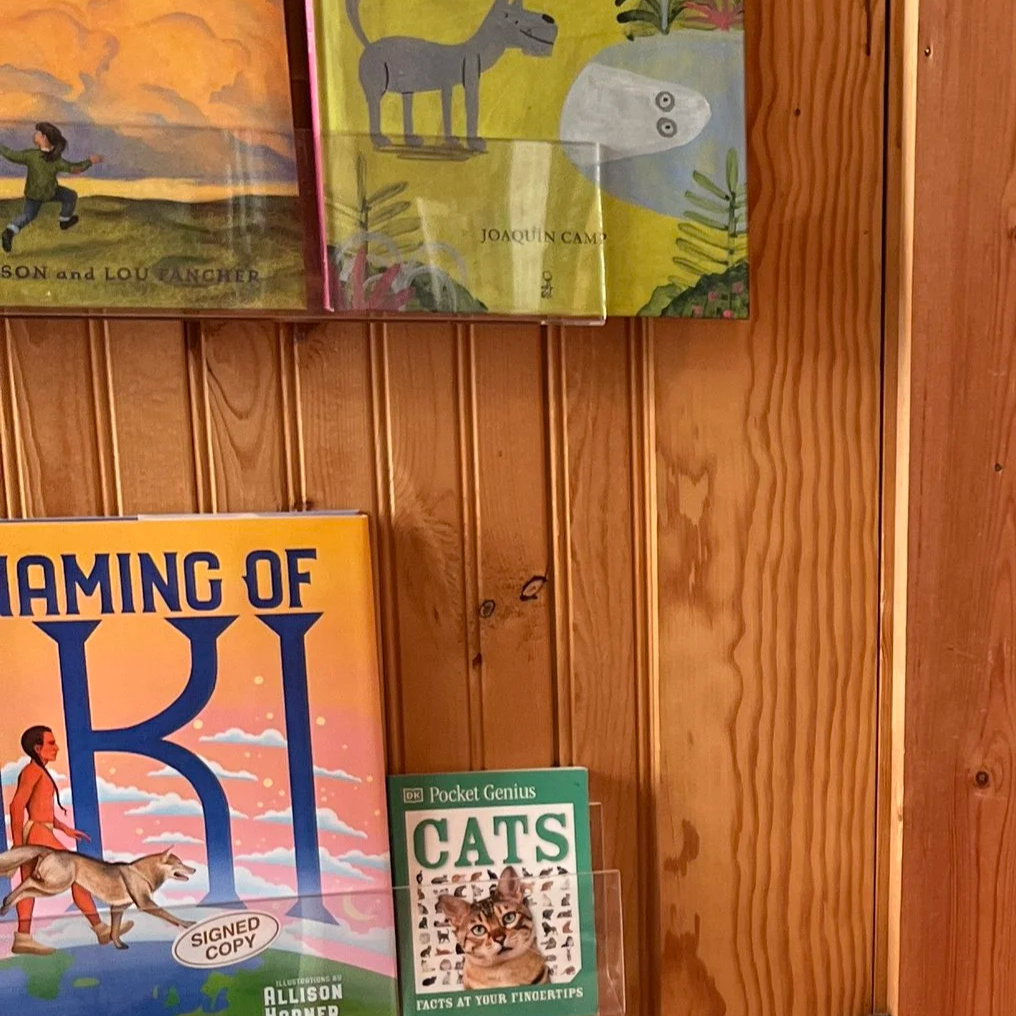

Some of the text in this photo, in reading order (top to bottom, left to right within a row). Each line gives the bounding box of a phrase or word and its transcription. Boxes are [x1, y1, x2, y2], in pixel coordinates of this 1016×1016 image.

[1, 264, 261, 284] SON and LOU FANCHER
[242, 548, 317, 609] OF
[404, 783, 537, 803] DK Pocket Genius
[413, 812, 570, 870] CATS
[191, 916, 260, 948] SIGNED
[205, 933, 257, 961] COPY
[263, 983, 343, 1007] ALLISON
[416, 987, 584, 1011] FACTS AT YOUR FINGERTIPS
